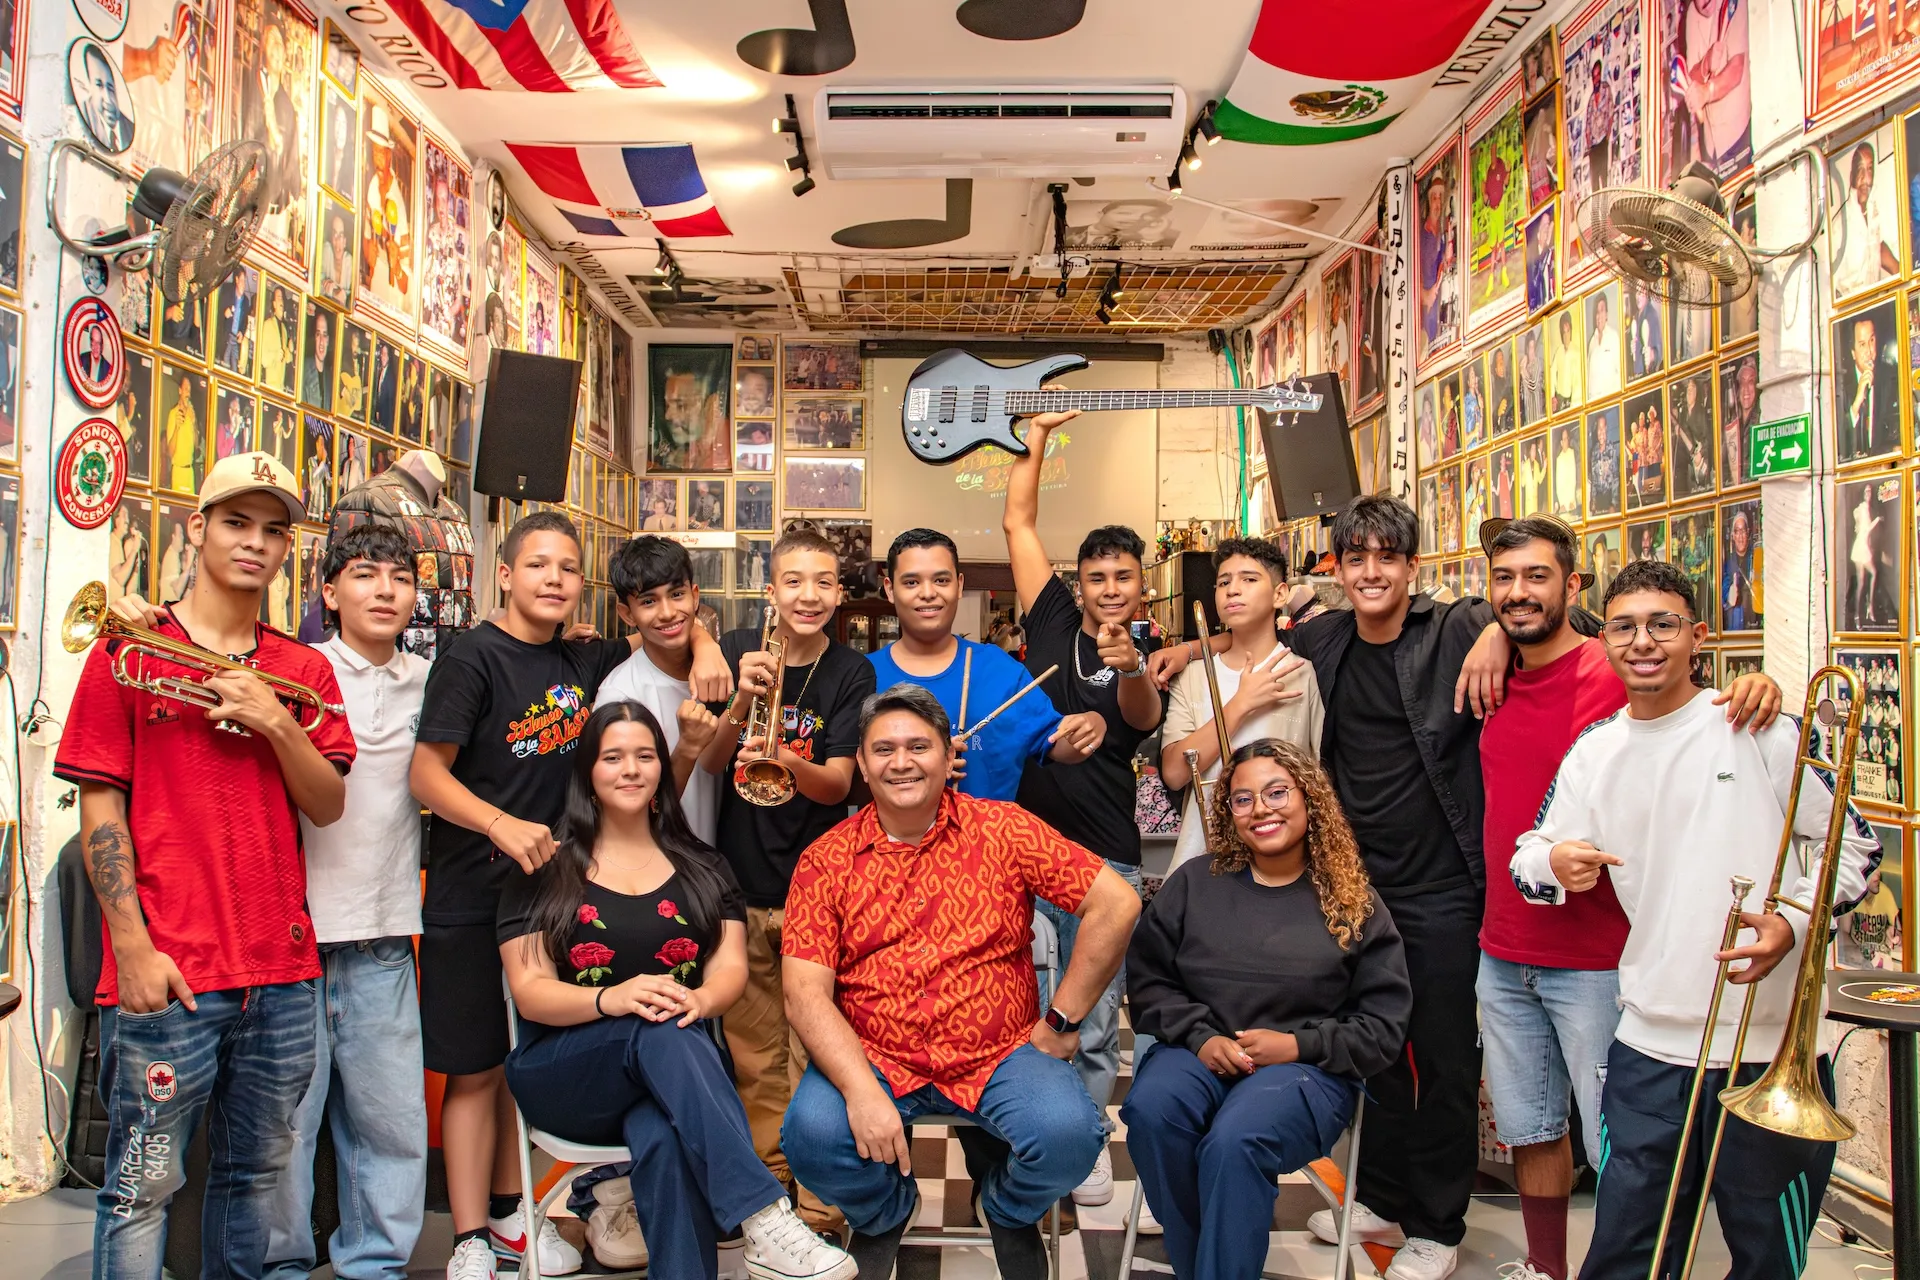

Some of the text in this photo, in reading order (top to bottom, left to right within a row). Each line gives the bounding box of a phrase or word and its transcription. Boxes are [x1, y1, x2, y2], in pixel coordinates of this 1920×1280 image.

[368, 33, 447, 88] RICO
[74, 426, 120, 456] SONORA
[1770, 426, 1776, 439] DE
[251, 456, 277, 487] LA
[65, 493, 111, 521] PONCEÑA
[511, 740, 526, 753] de
[527, 739, 538, 751] la
[143, 1133, 171, 1180] 64/95
